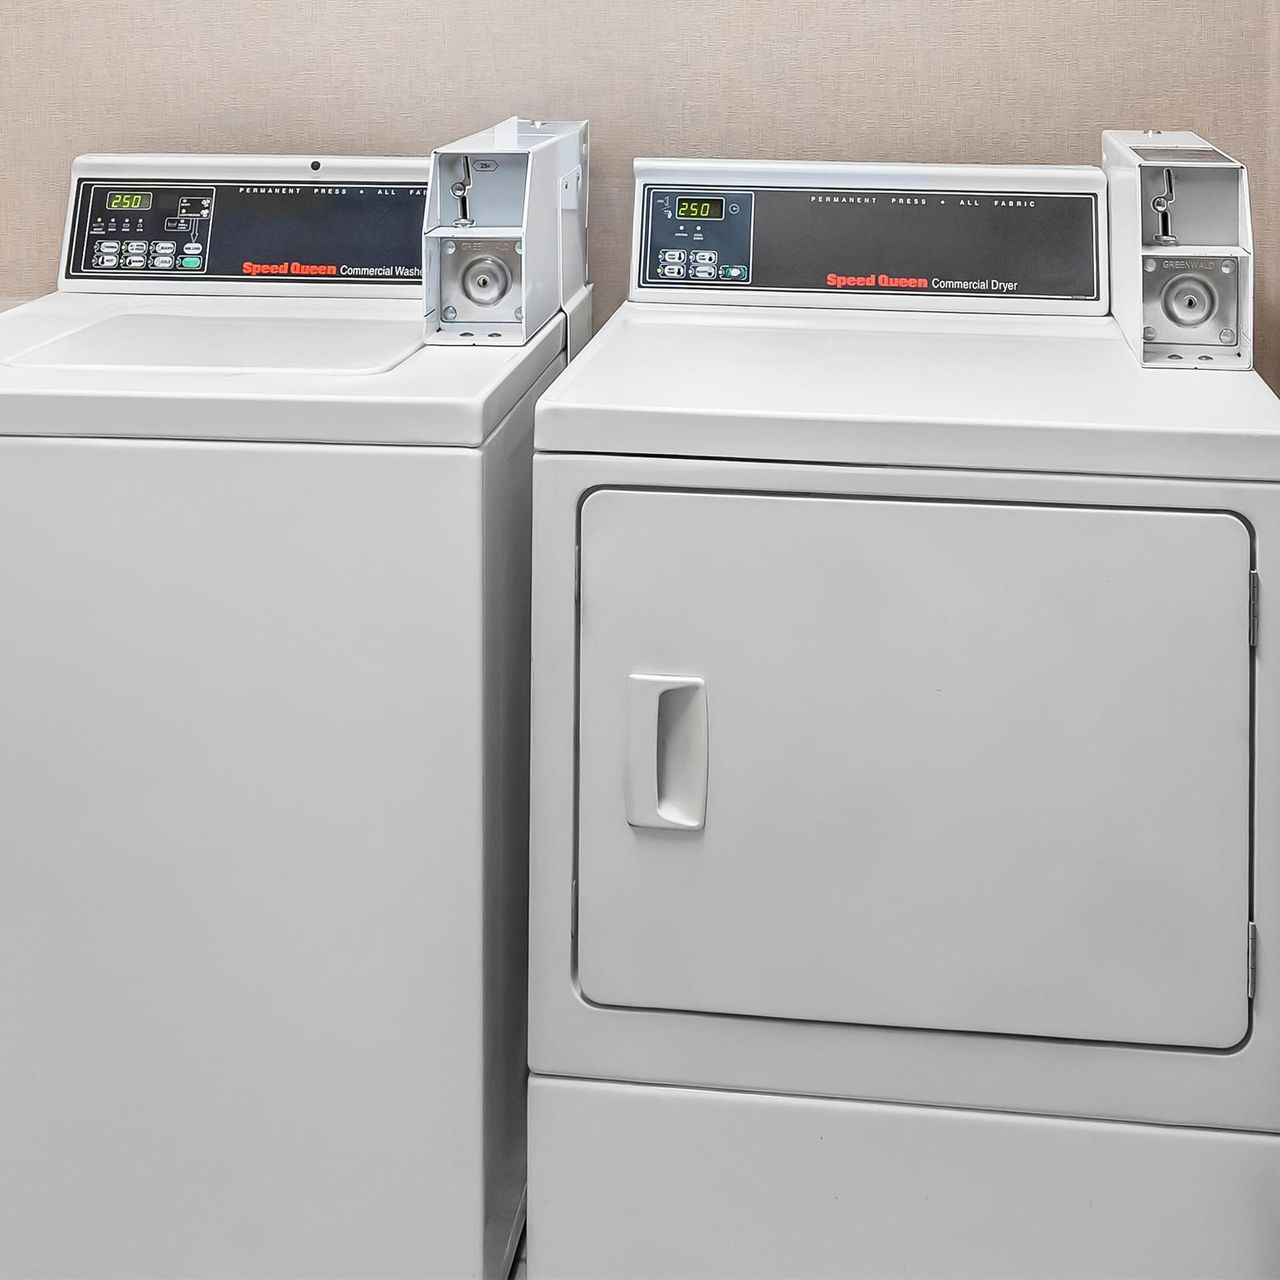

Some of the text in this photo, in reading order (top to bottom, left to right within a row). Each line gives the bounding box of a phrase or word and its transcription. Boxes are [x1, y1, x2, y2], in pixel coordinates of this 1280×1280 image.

[111, 195, 142, 208] 250
[891, 197, 927, 205] PRESS
[993, 200, 1036, 208] FABRIC
[678, 202, 710, 217] 250
[242, 261, 289, 276] Speed
[290, 262, 337, 275] Queen
[340, 265, 392, 276] Commercial
[1162, 260, 1215, 270] GREENWALD
[826, 273, 1018, 293] Speed Queen Commercial Dryer
